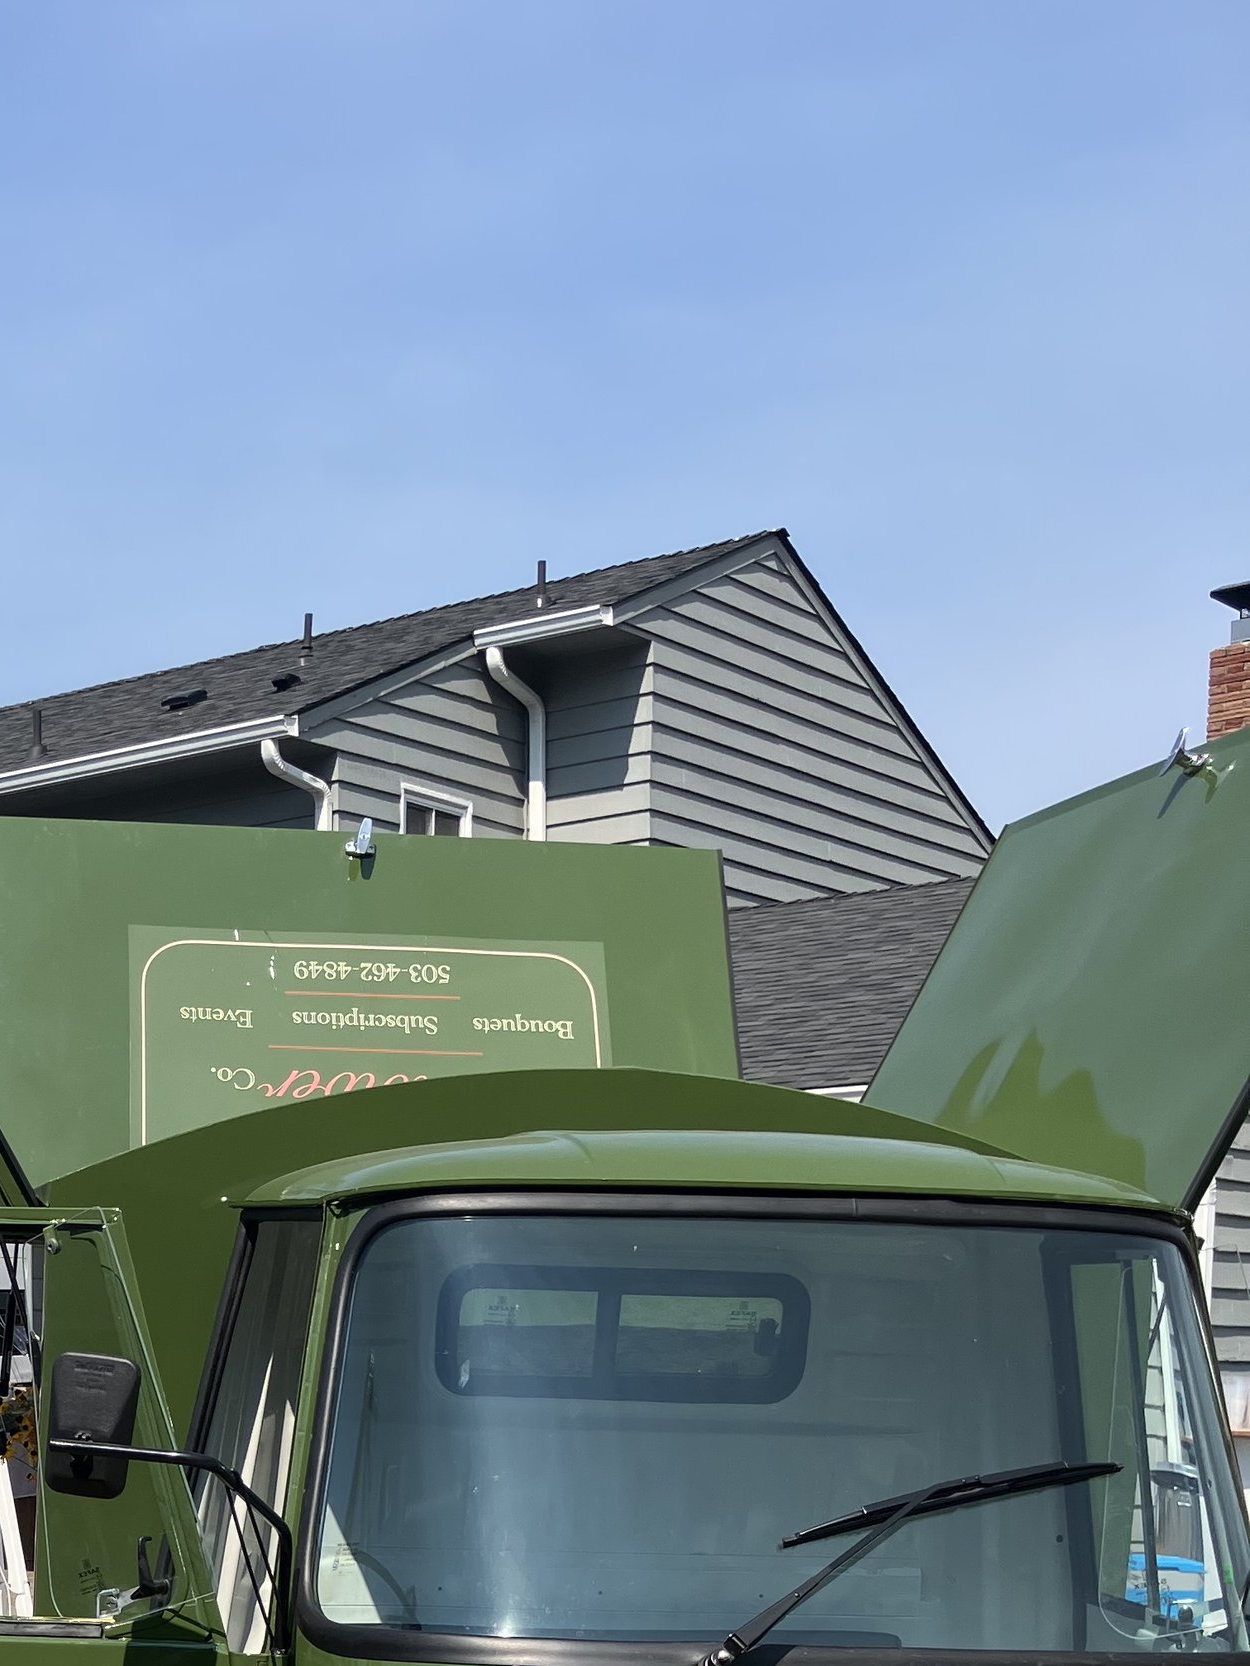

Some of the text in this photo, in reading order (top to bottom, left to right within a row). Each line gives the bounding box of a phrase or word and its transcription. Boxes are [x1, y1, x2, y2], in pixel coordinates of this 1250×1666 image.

[293, 960, 451, 984] 503-462-4849
[179, 1006, 575, 1040] Bouquets Subscriptions Events
[210, 1067, 256, 1090] Co.
